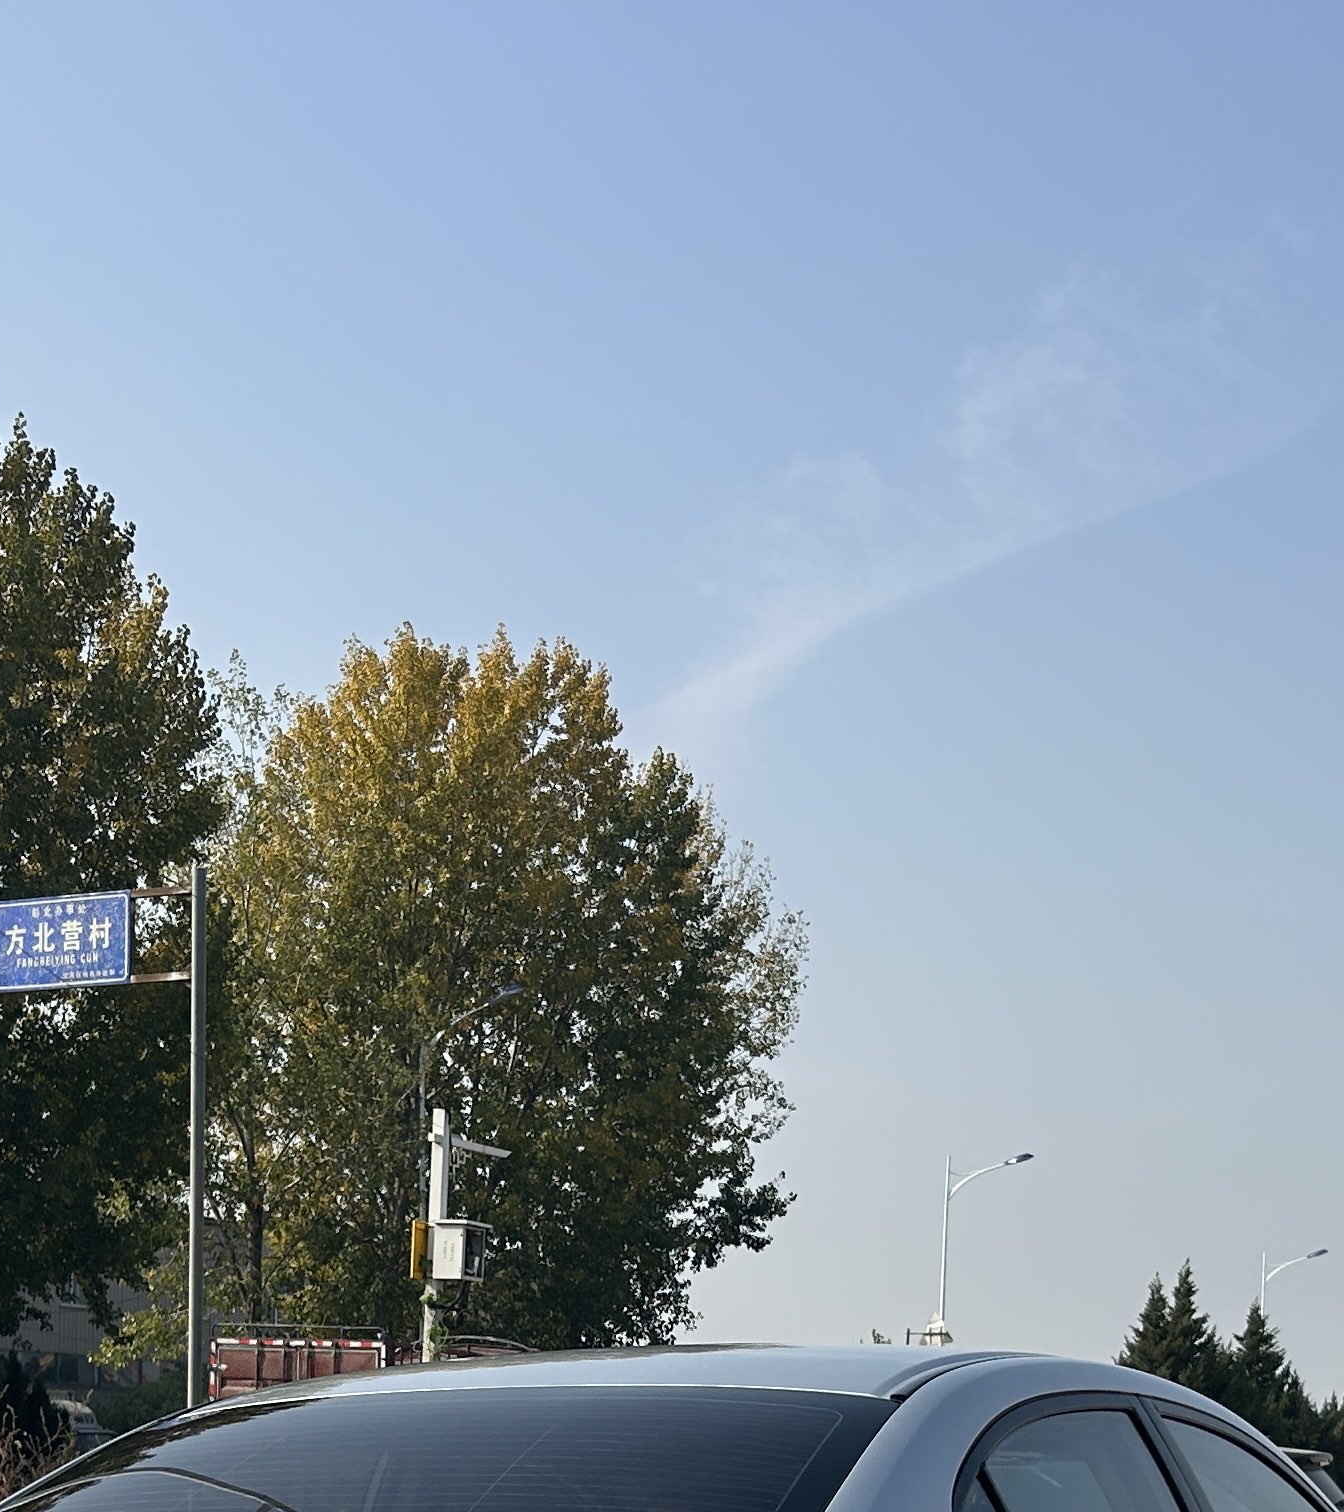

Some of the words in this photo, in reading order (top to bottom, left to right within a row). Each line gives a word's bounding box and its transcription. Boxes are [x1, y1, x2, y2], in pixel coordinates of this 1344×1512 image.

[5, 916, 113, 956] 方北营村
[80, 951, 99, 964] CUN
